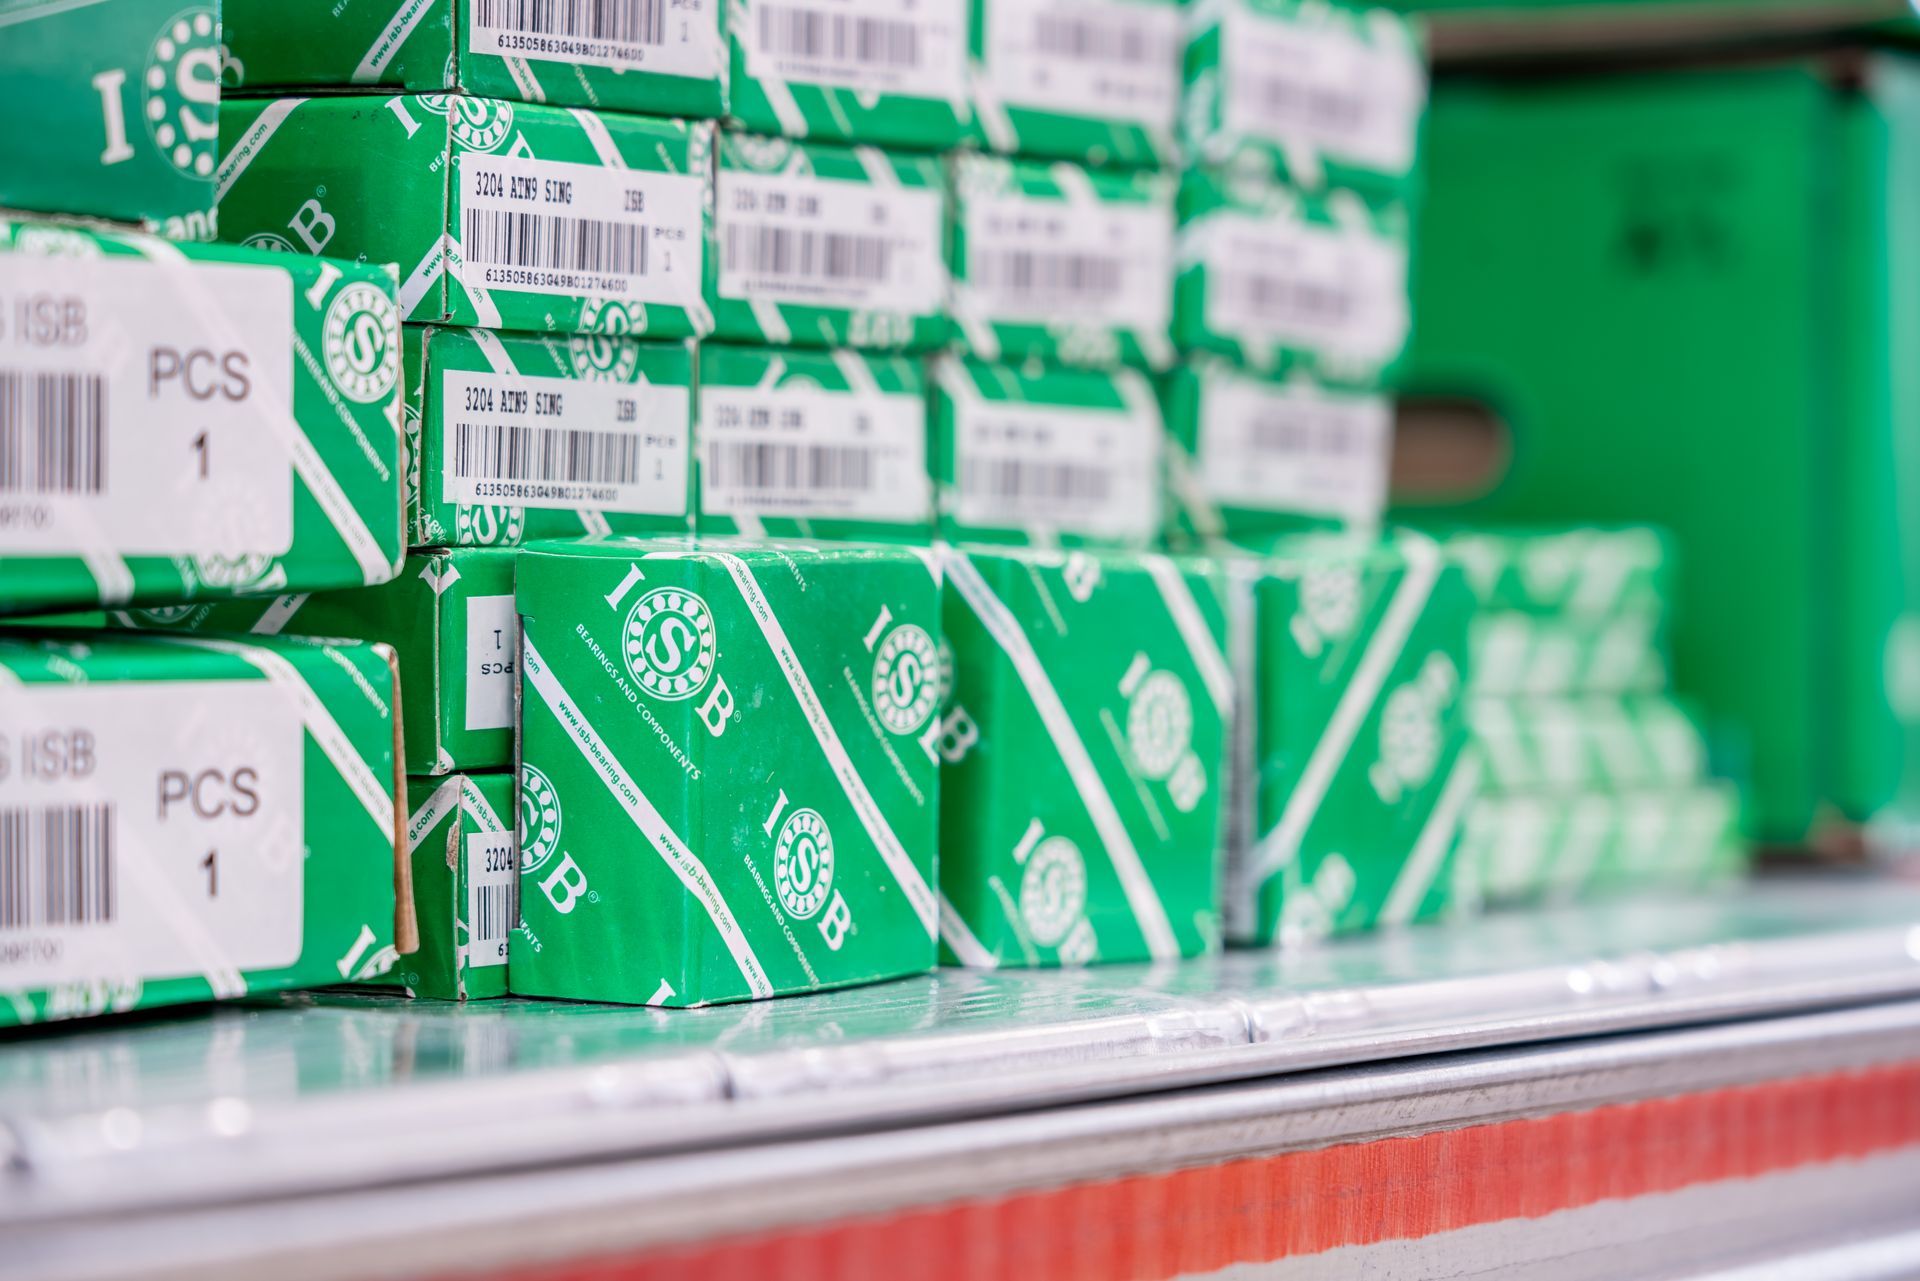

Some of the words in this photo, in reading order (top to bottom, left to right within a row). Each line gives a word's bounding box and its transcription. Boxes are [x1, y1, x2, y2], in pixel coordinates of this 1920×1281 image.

[476, 171, 503, 198] 3204
[510, 176, 538, 201] ATN9
[545, 179, 572, 205] SING
[664, 251, 672, 272] 1
[148, 346, 252, 402] PCS
[465, 386, 493, 412] 3204
[500, 390, 528, 414] ATN9
[535, 392, 562, 417] SING
[190, 430, 211, 480] 1
[481, 662, 514, 676] PCS
[575, 623, 619, 679] BEARINGS
[615, 676, 638, 704] AND
[635, 702, 702, 781] COMPONENTS
[20, 729, 97, 782] ISB
[558, 699, 639, 807] www.isb-bearing.com
[156, 766, 262, 821] PCS
[200, 848, 220, 899] 1
[485, 846, 513, 873] 3204
[659, 832, 733, 934] www.isb-bearing.com
[743, 853, 773, 905] BEARINGS
[769, 902, 786, 927] AND
